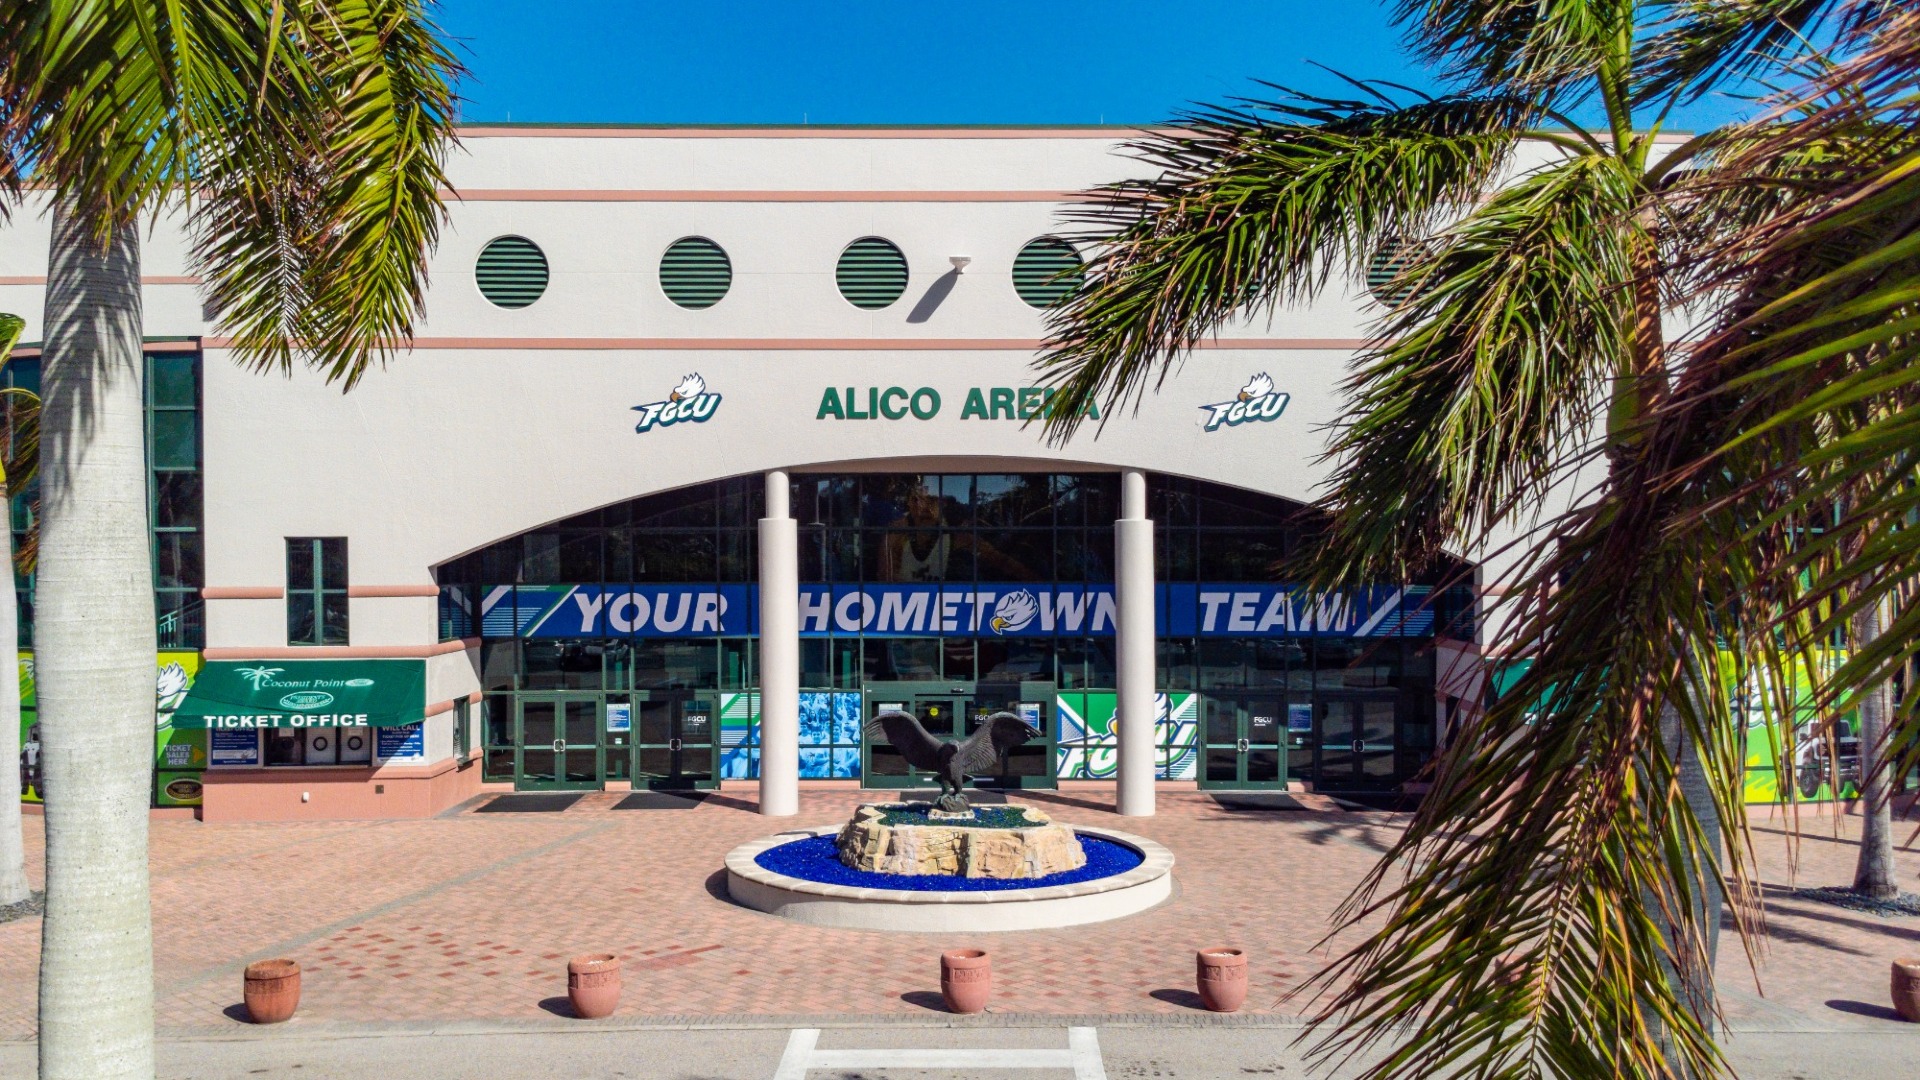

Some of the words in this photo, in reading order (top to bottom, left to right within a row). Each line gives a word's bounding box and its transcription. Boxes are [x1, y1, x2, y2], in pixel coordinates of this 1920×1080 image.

[630, 393, 722, 433] FGCU
[816, 386, 942, 420] ALICO
[960, 387, 1100, 420] AREA
[1198, 393, 1290, 432] FGCU
[573, 592, 728, 633] YOUR
[1200, 592, 1350, 632] TEAM
[261, 678, 309, 688] Coconut
[312, 678, 345, 688] Point
[203, 715, 283, 728] TICKET
[290, 714, 368, 728] OFFICE
[687, 715, 707, 723] FGCU
[164, 744, 192, 752] TICKET
[1057, 720, 1197, 778] FGU
